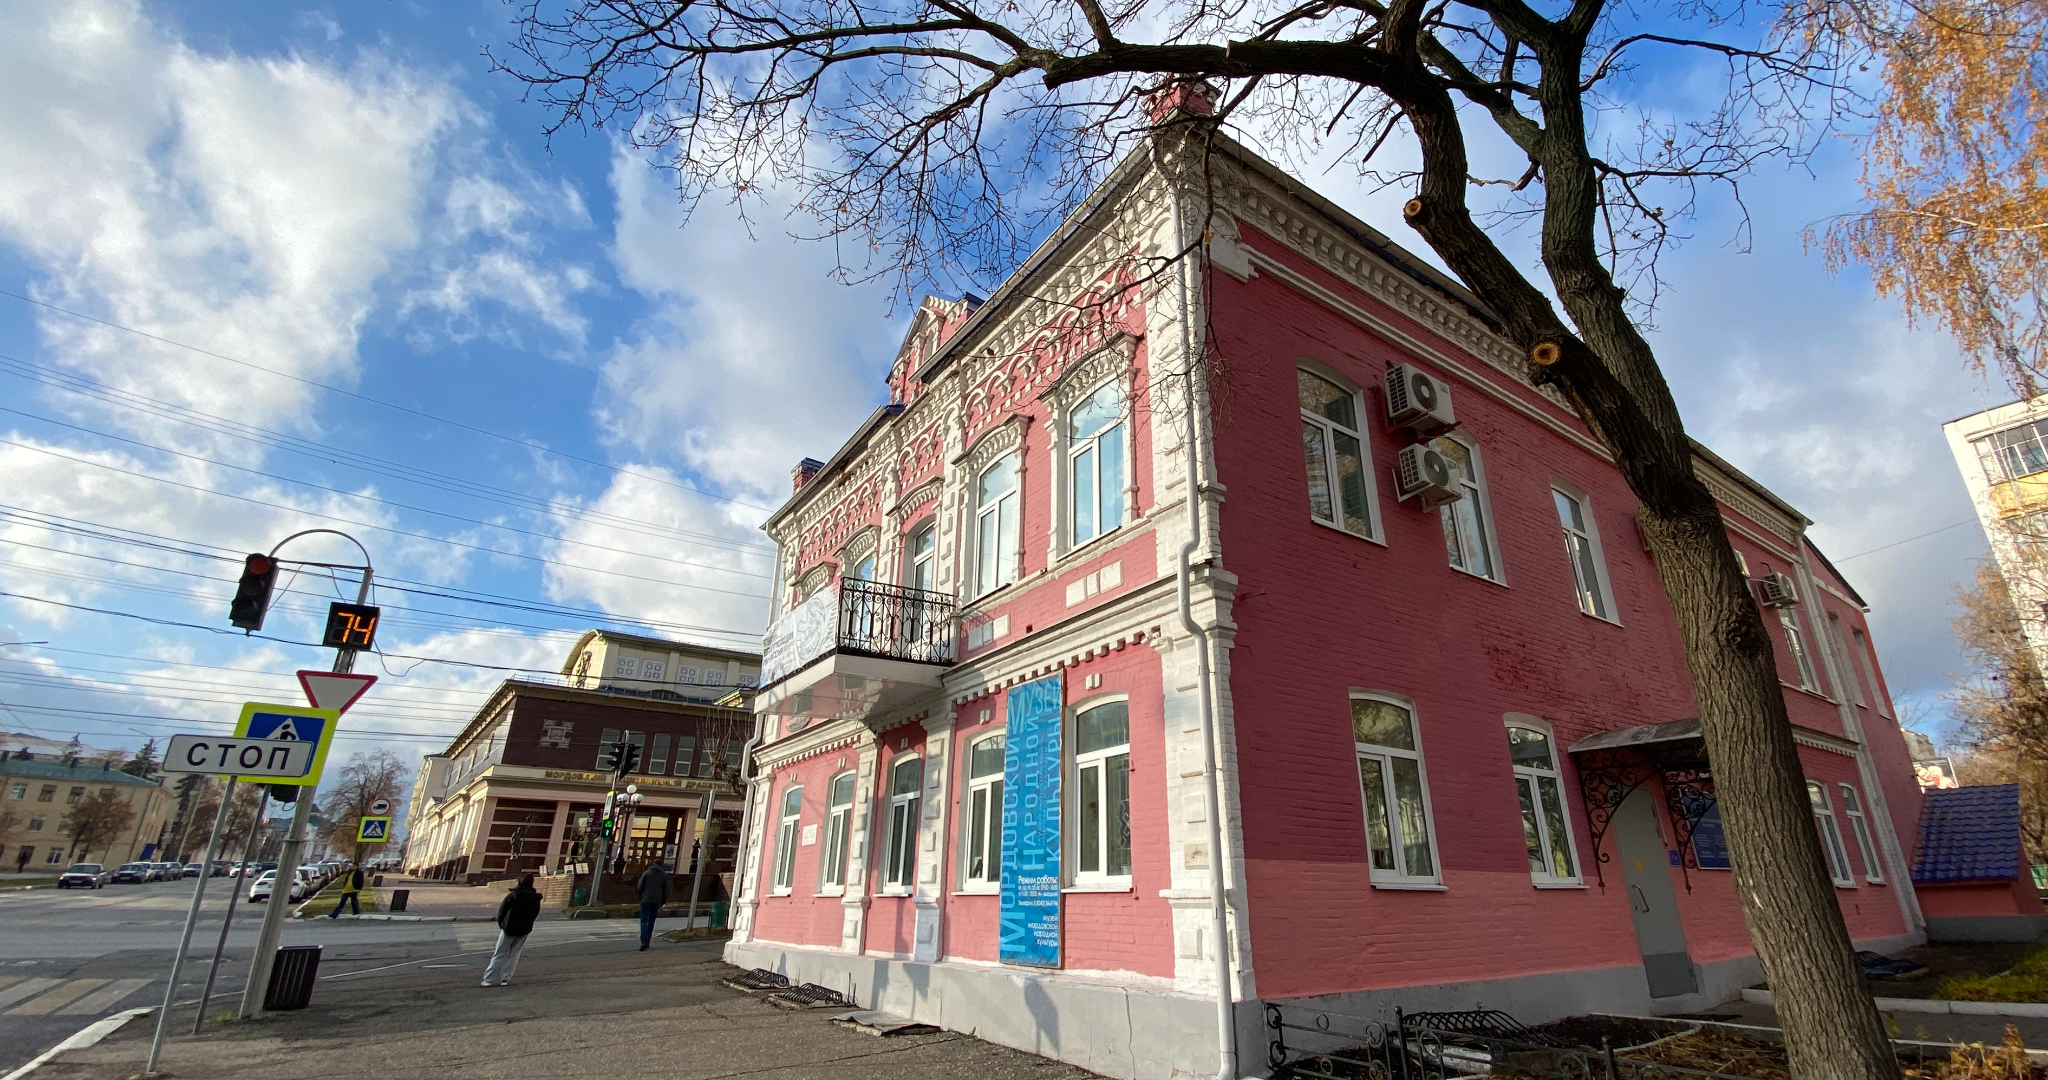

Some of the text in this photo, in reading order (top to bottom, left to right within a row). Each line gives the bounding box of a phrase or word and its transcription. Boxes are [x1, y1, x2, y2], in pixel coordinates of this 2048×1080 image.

[338, 611, 376, 645] 74
[187, 742, 291, 770] СТОП
[1023, 716, 1045, 870] НАРОДНОЙ
[1046, 717, 1061, 862] КУЛЬТУРЫ
[1018, 875, 1036, 884] Режим
[1043, 914, 1058, 922] музей
[1028, 922, 1059, 930] мордовской
[1034, 930, 1059, 938] народной
[1037, 939, 1058, 947] культуры
